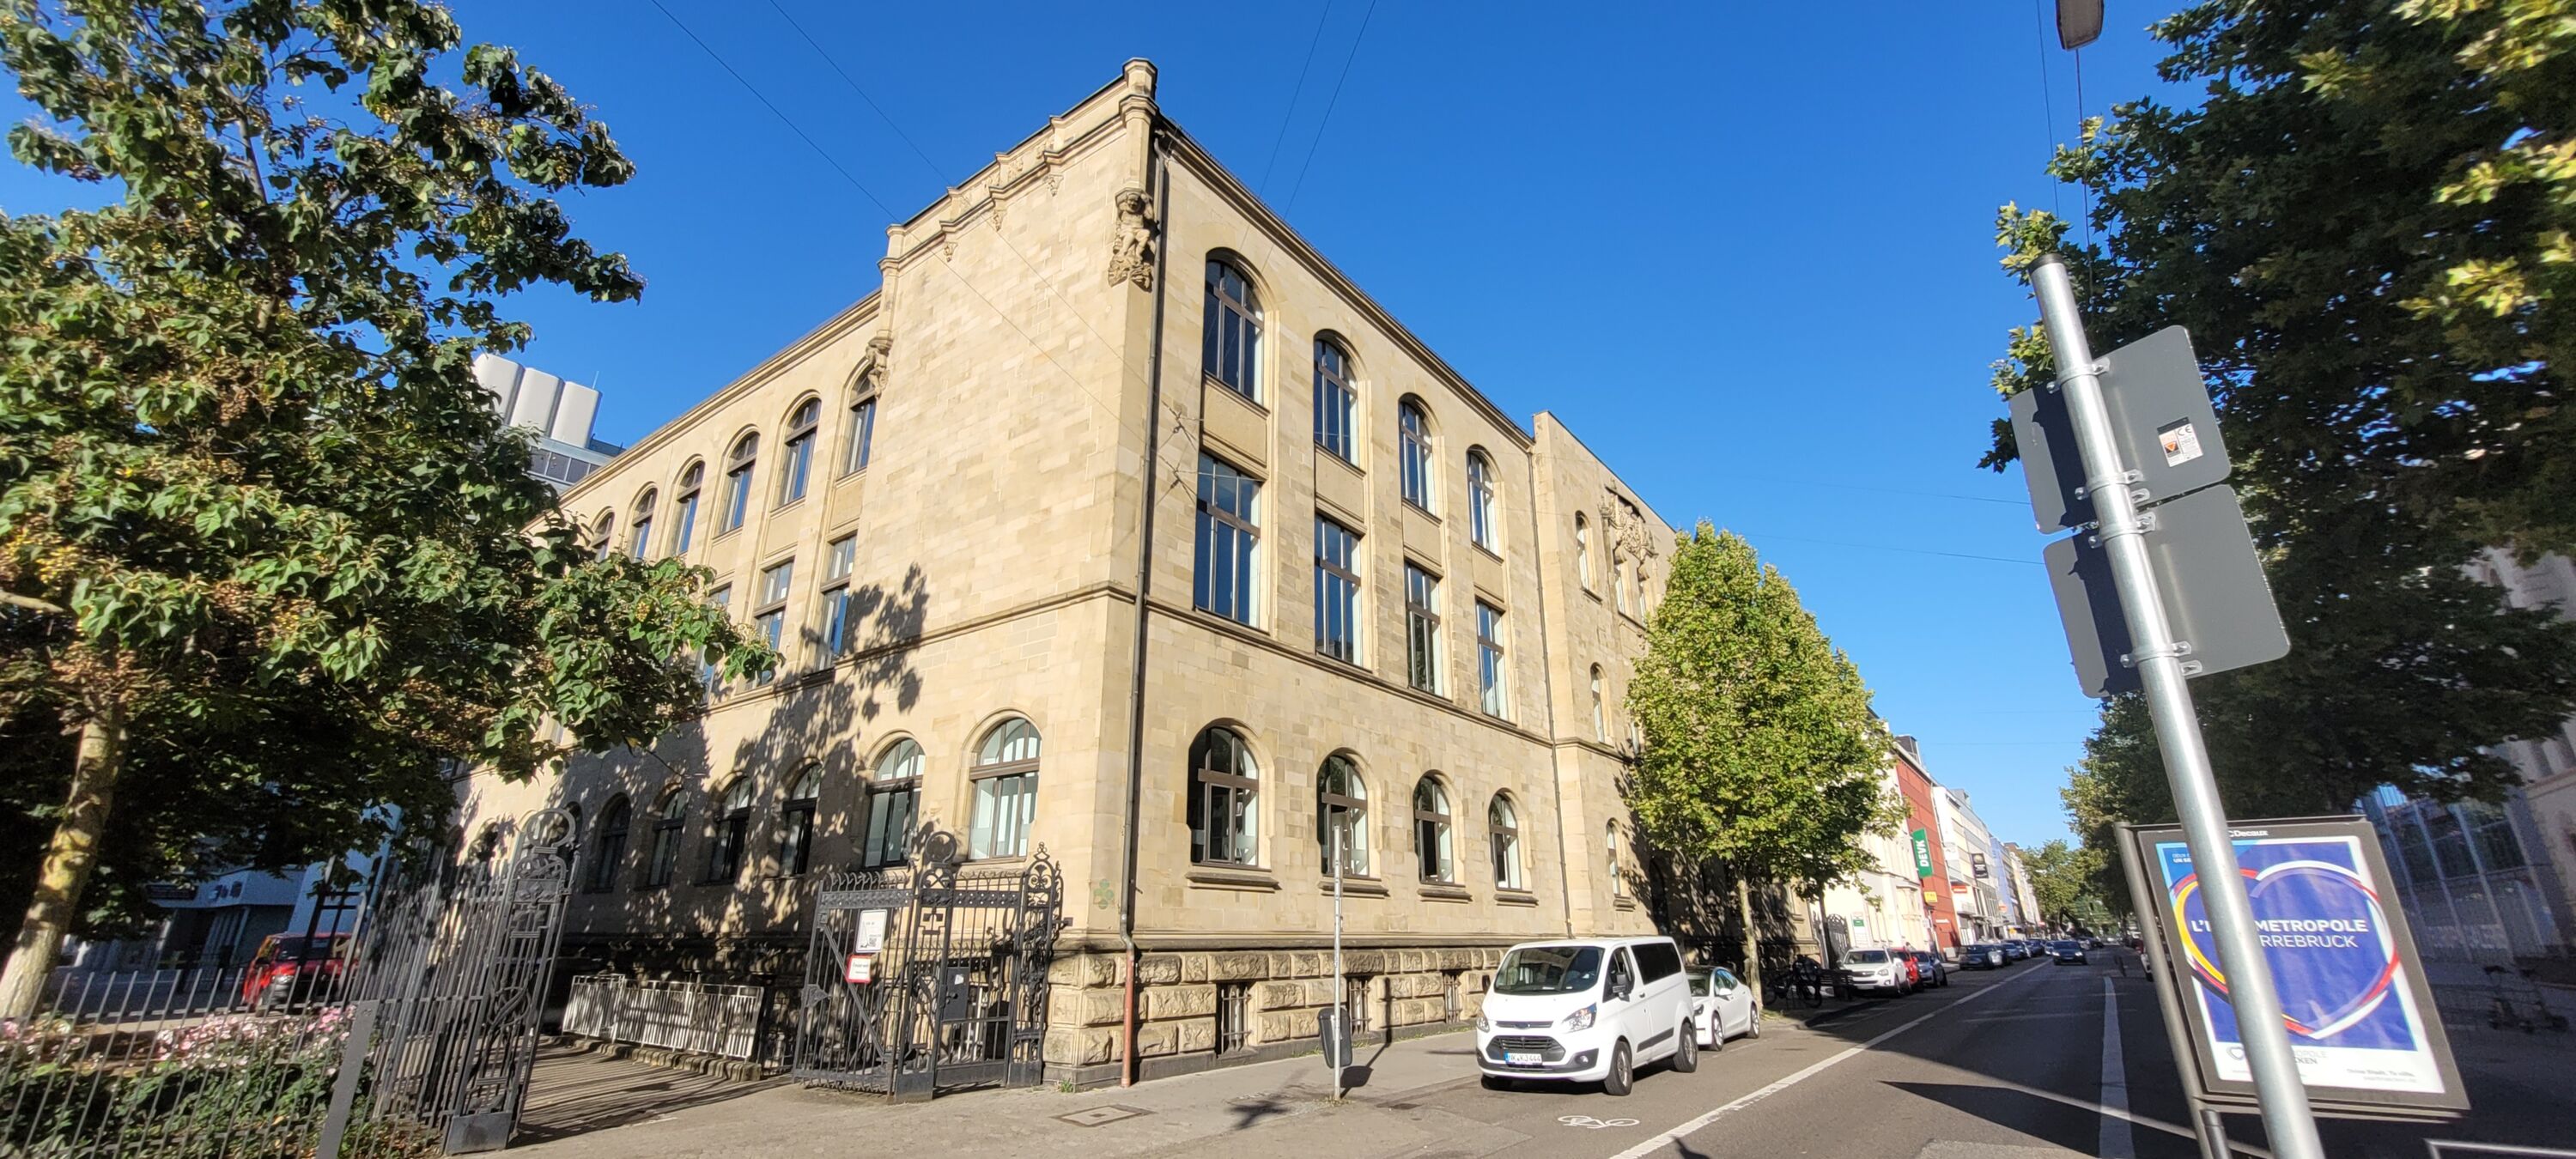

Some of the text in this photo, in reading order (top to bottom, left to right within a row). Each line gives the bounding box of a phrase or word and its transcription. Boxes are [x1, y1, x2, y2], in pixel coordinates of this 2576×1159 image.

[2227, 829, 2269, 838] CDecaux
[1916, 840, 1929, 867] DEVK
[2259, 934, 2358, 948] RREBRUCK
